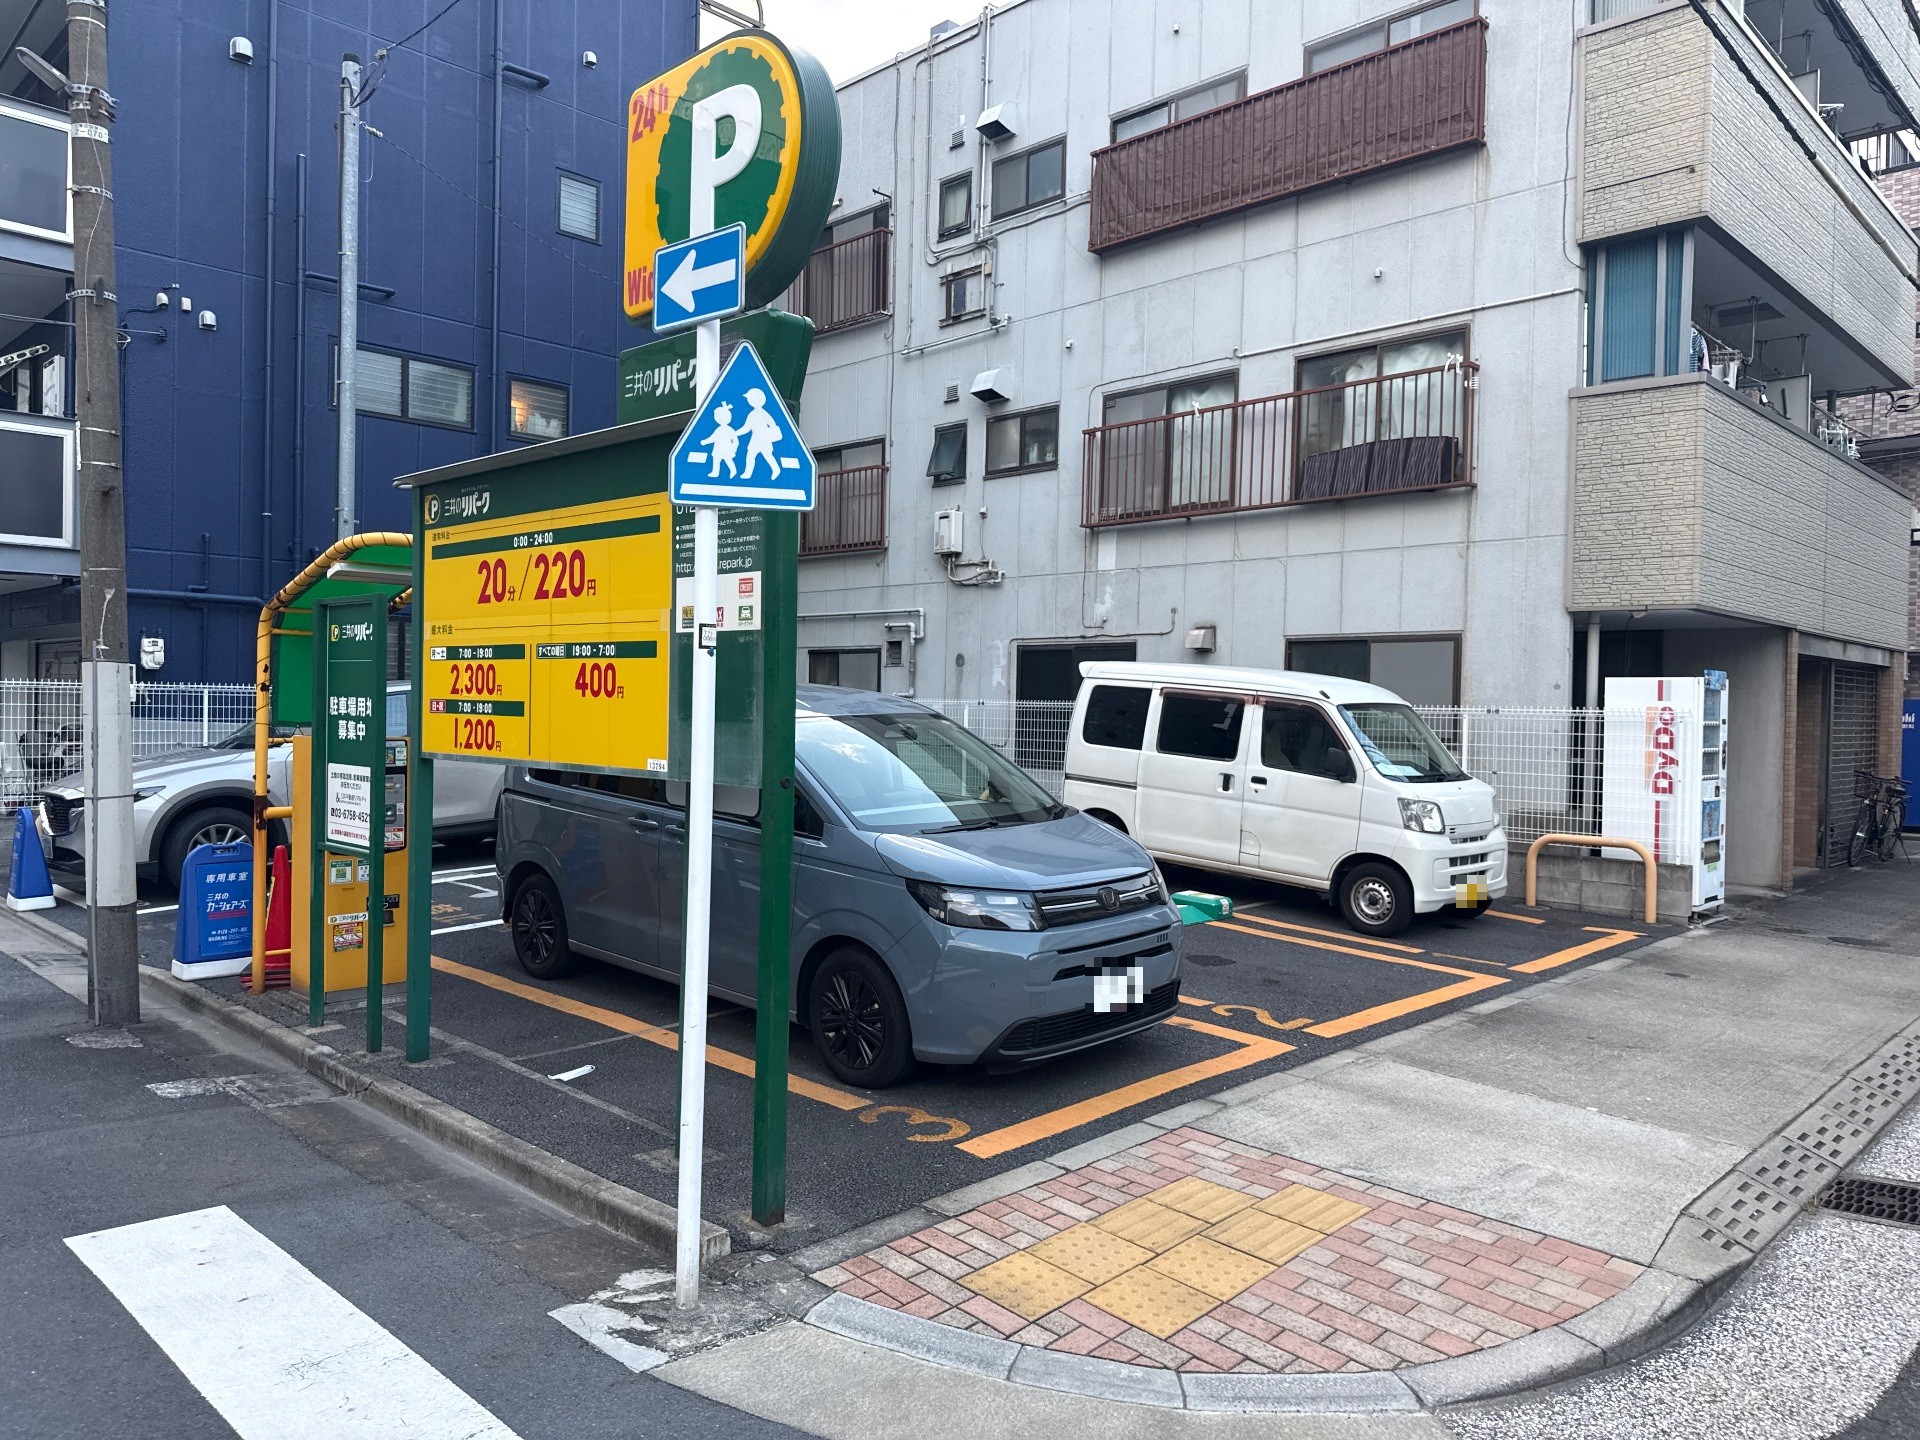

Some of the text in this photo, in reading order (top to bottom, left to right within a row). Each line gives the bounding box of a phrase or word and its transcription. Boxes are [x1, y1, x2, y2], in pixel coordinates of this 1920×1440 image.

[689, 83, 762, 238] P
[444, 491, 490, 517] 三井のリパーク
[431, 625, 453, 635] 最大料金
[575, 662, 624, 699] 400円
[338, 720, 366, 741] 募集中
[205, 871, 249, 883] 専用車室
[206, 892, 230, 902] 三井の
[1210, 1003, 1316, 1031] 2
[857, 1104, 973, 1143] 3
